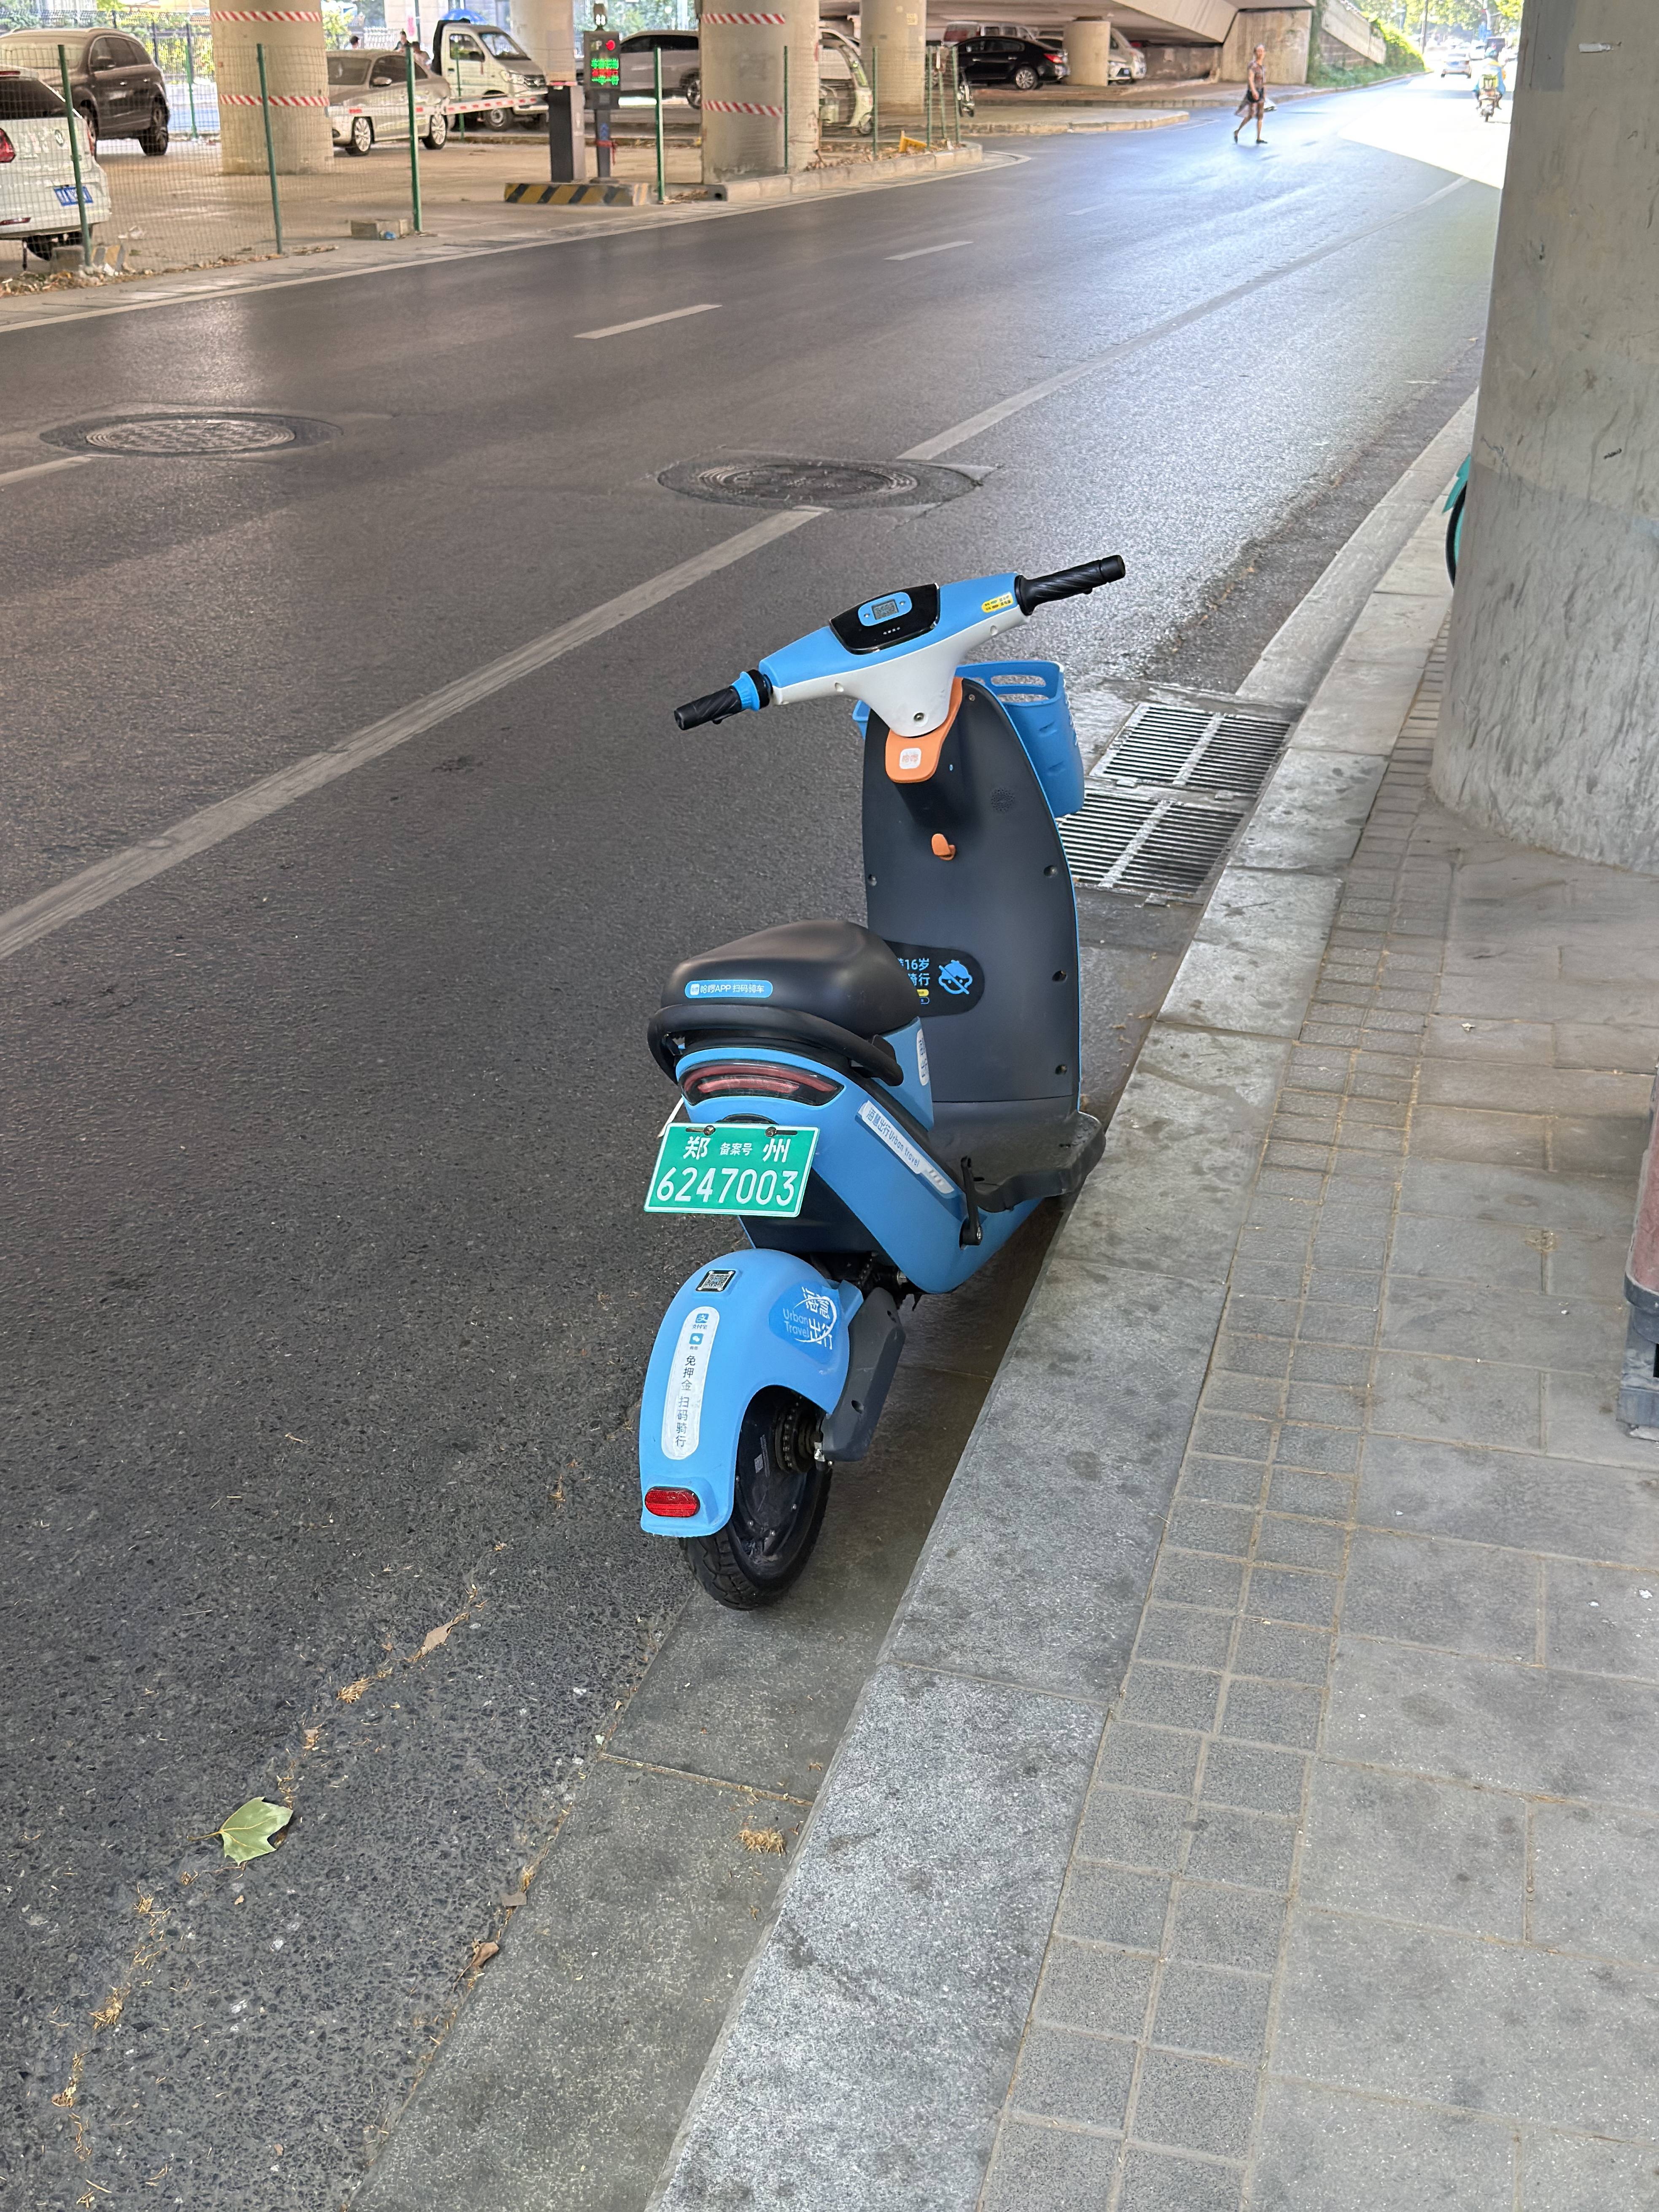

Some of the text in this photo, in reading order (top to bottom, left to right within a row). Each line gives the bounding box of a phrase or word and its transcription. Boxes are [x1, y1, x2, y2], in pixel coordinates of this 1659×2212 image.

[733, 984, 764, 993] 扫码骑车
[683, 1136, 792, 1163] 郑 备案号 州
[889, 1130, 904, 1151] Urban
[904, 1147, 920, 1167] travel
[657, 1167, 798, 1206] 6247003
[783, 1308, 809, 1325] Urban
[784, 1320, 810, 1338] Travel
[675, 1355, 696, 1447] 免押金 扫码骑行
